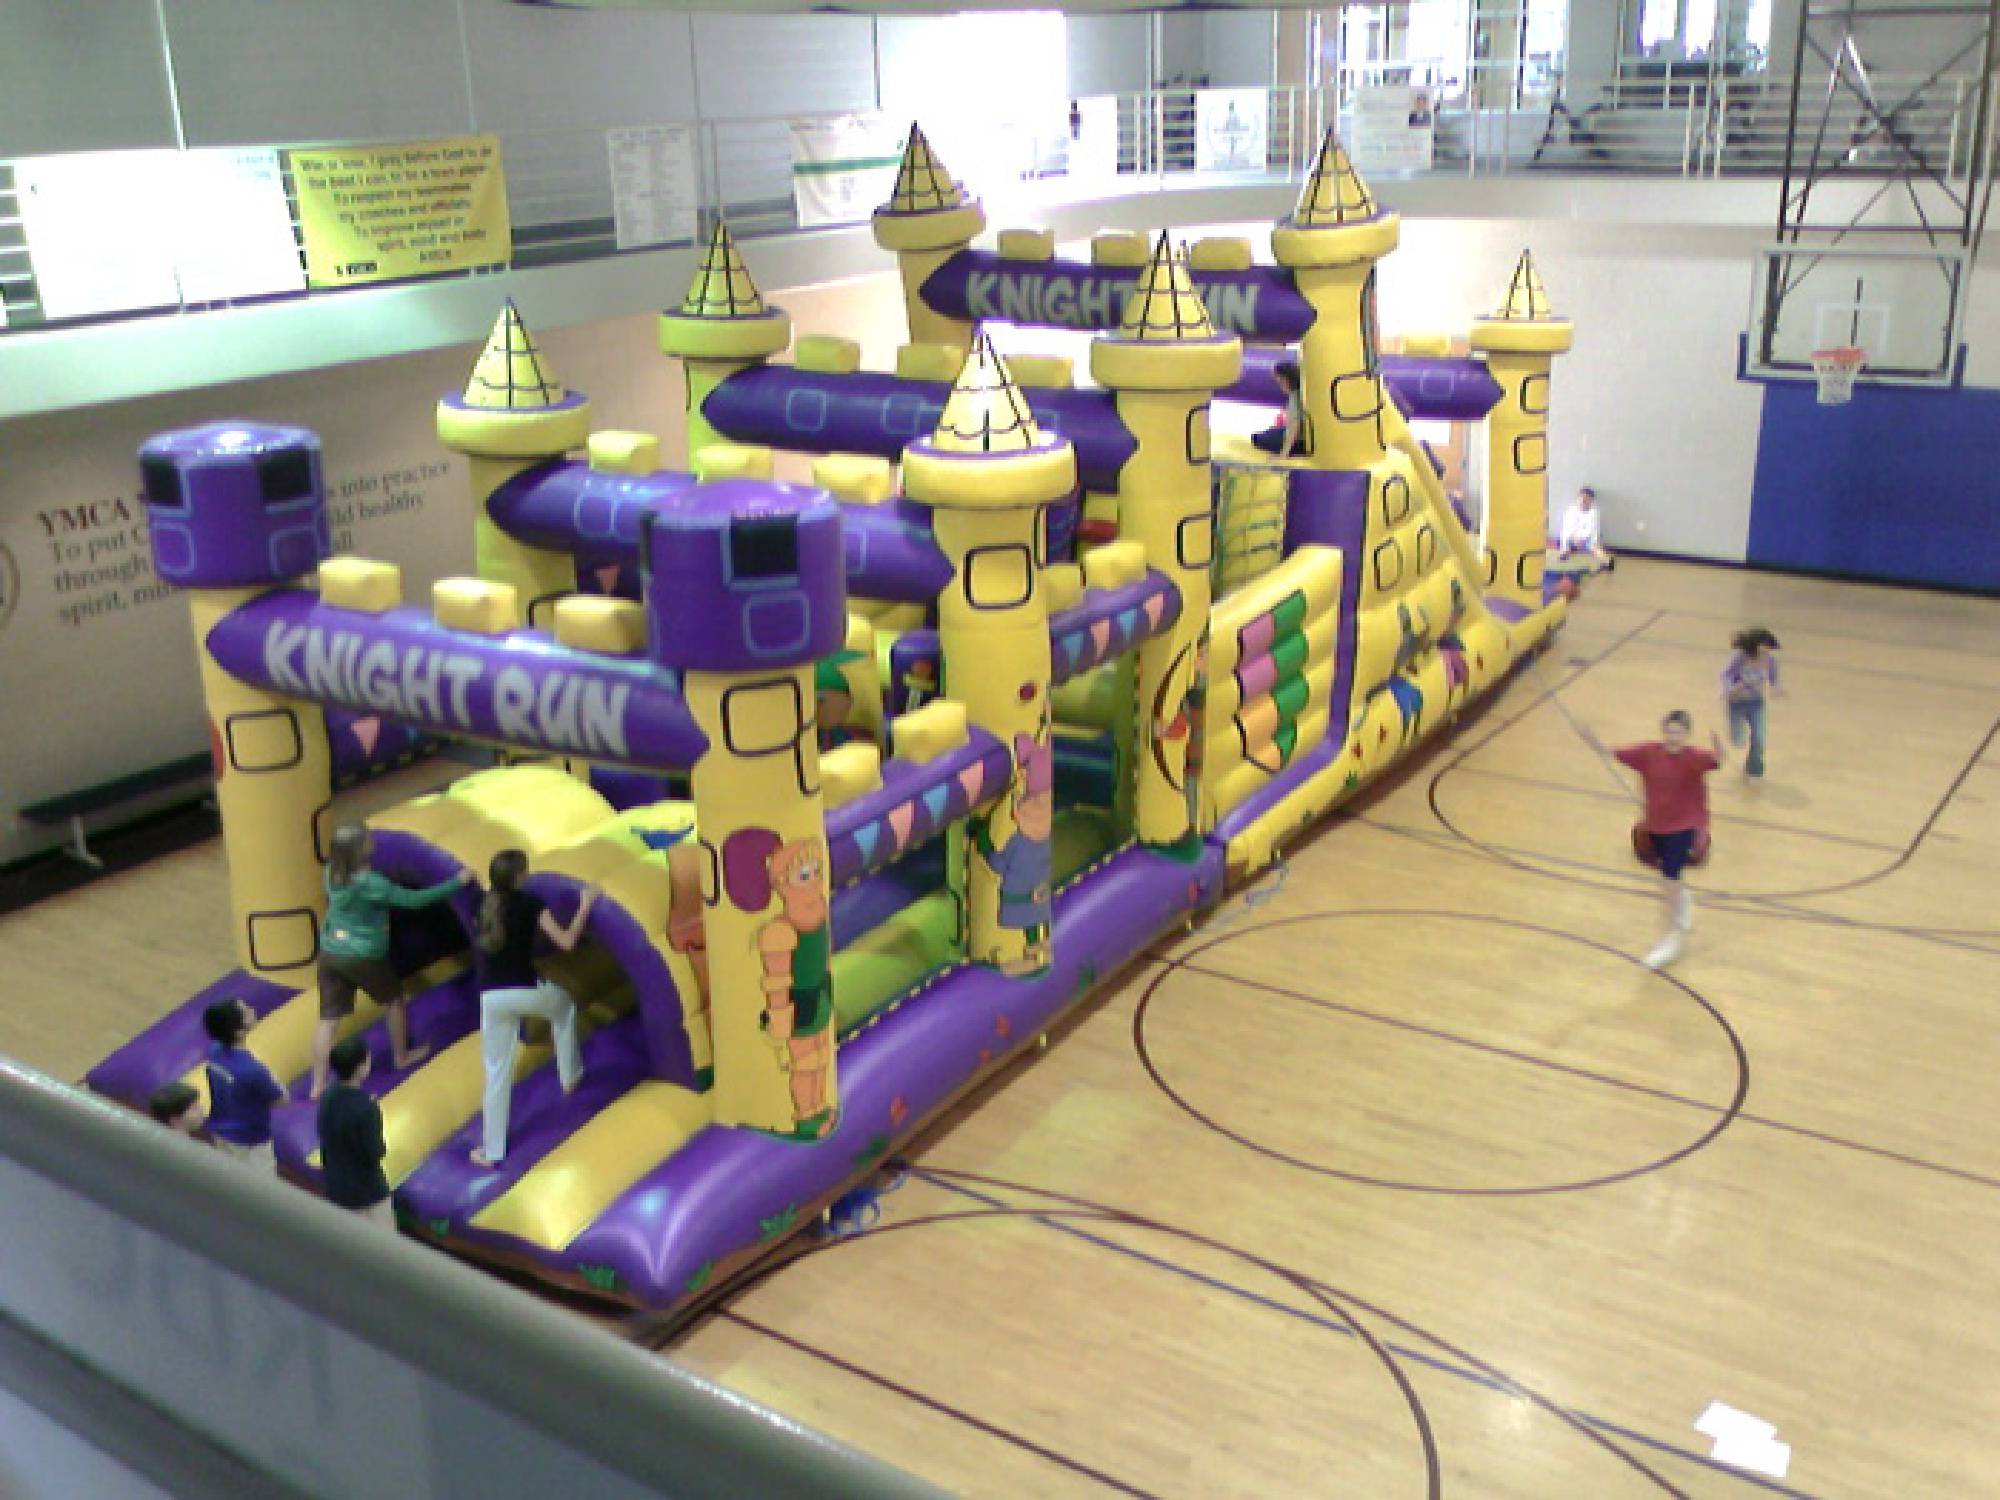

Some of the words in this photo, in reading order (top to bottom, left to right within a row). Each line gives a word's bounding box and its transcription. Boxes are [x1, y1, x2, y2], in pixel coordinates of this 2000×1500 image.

[340, 475, 378, 497] into
[358, 490, 425, 518] healthy
[36, 496, 131, 537] YMCA
[48, 540, 82, 564] To
[88, 531, 126, 562] put
[53, 554, 149, 594] through
[265, 620, 483, 727] KNIGHT
[494, 663, 630, 758] RUN
